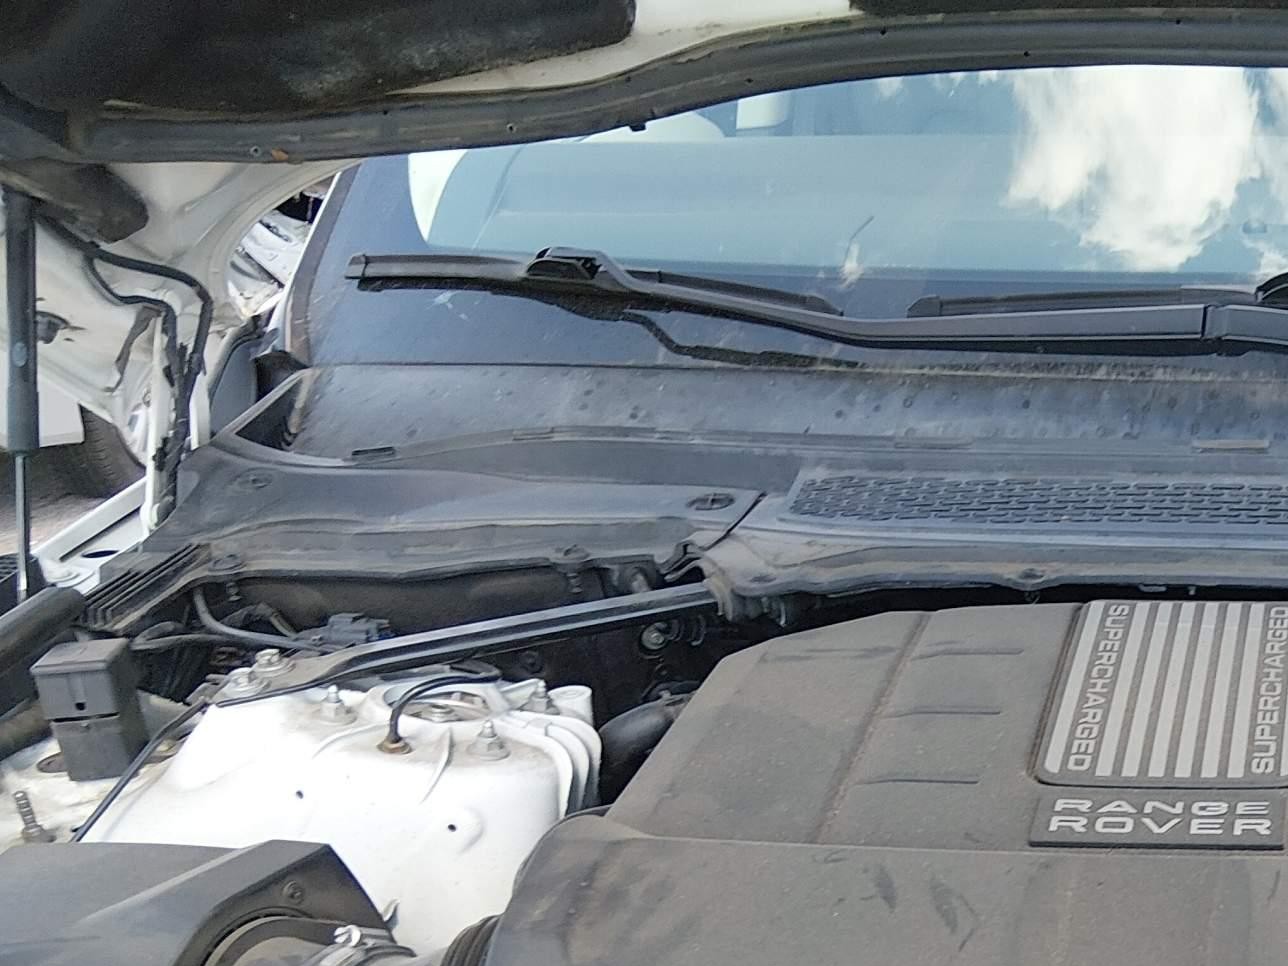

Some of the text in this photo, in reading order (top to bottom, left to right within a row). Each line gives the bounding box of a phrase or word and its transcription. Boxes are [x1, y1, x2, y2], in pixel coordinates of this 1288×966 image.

[1067, 604, 1130, 771] SUPERCHARGED
[1053, 798, 1271, 815] RANGE
[1048, 816, 1272, 836] ROVER
